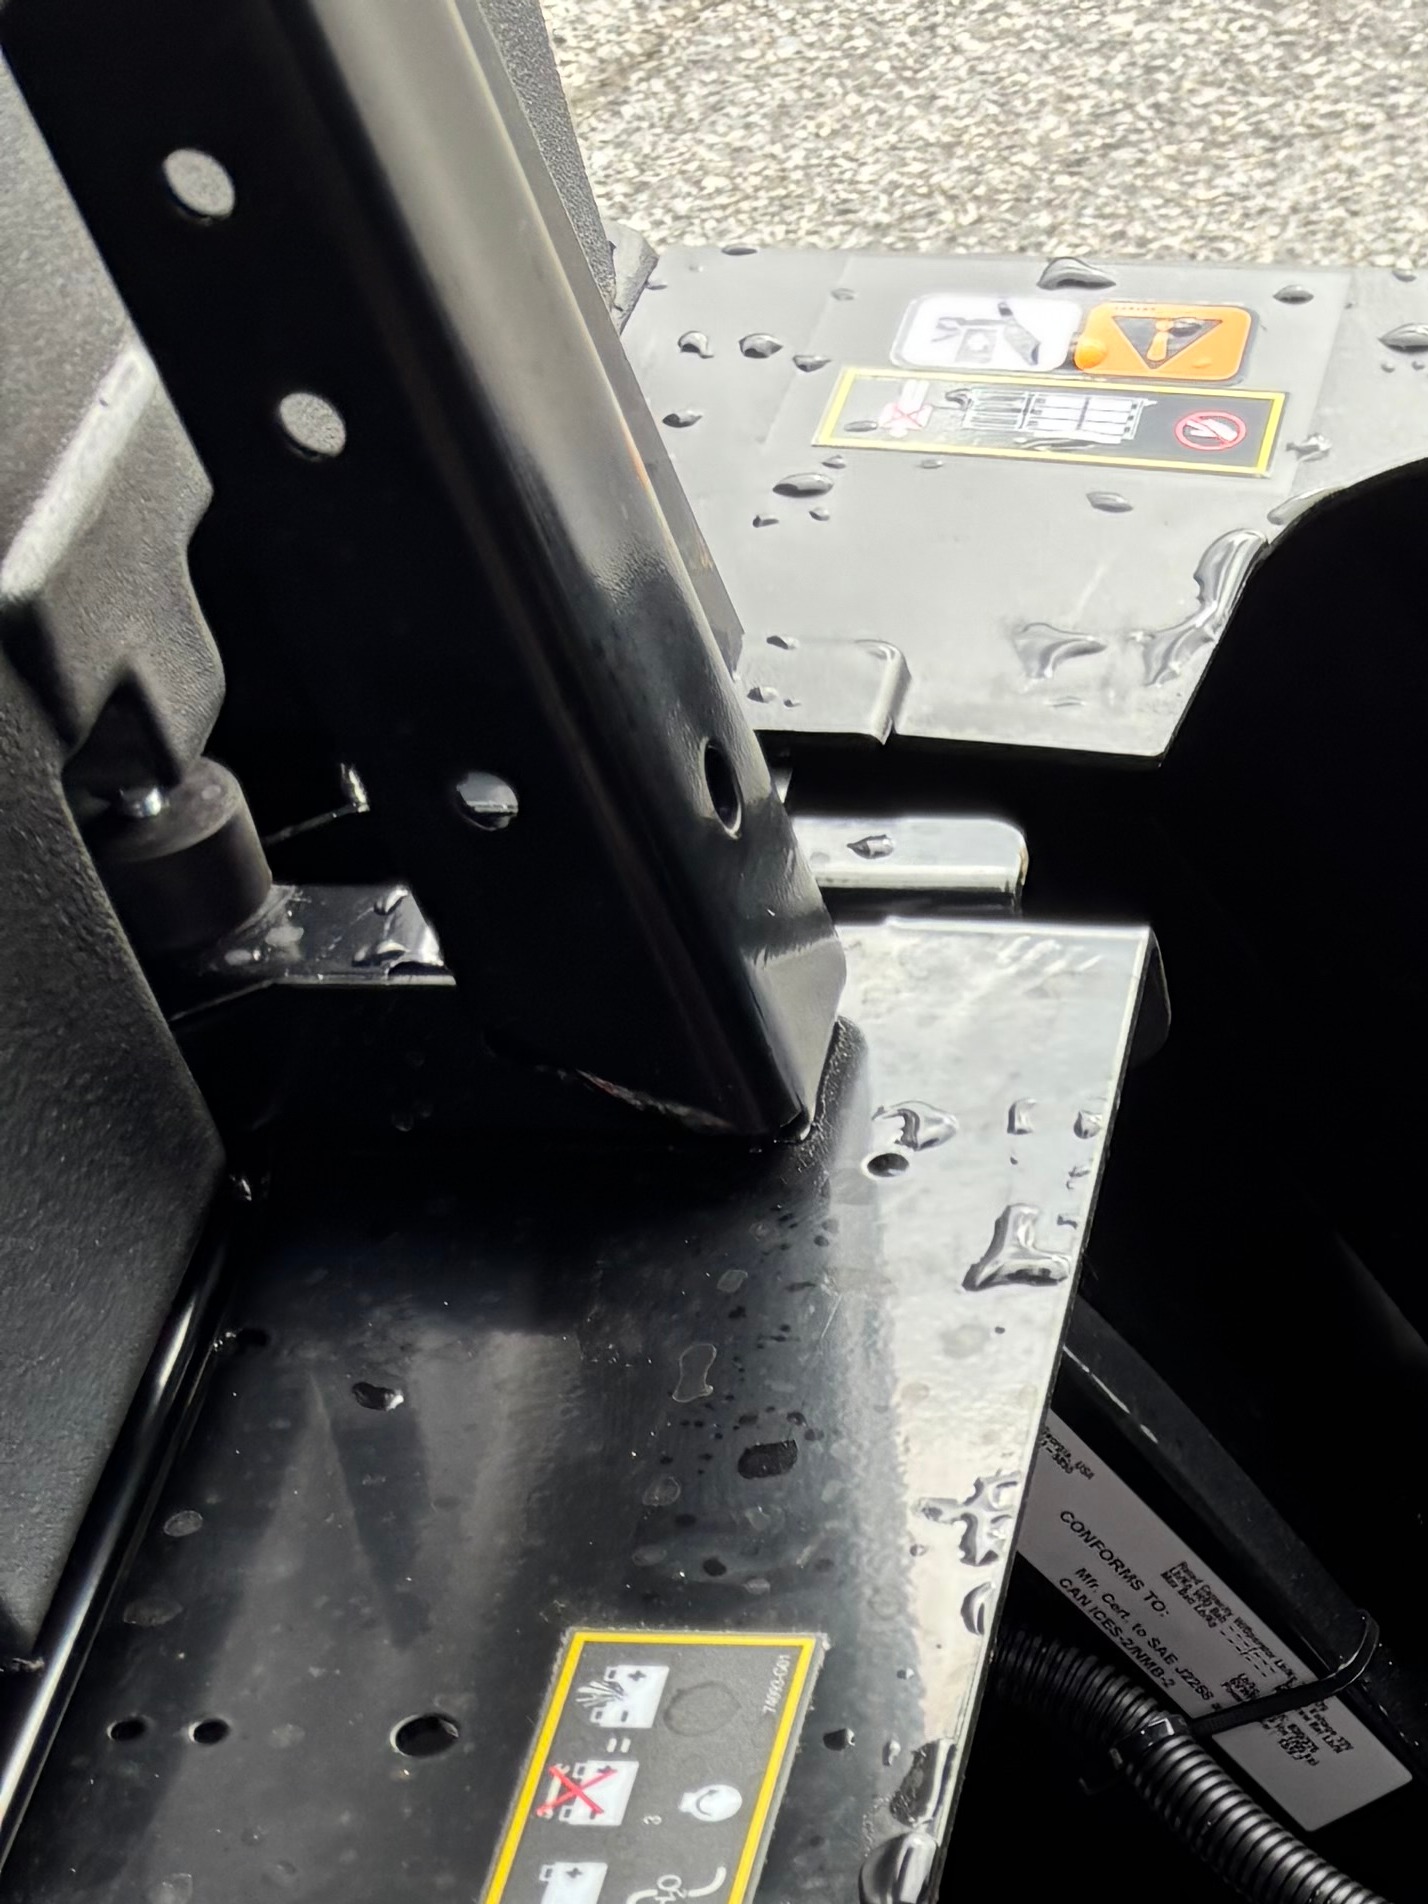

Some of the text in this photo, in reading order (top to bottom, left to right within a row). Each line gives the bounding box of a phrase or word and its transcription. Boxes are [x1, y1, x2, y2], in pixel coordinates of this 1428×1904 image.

[1073, 1458, 1095, 1481] USA
[1056, 1509, 1173, 1618] CONFORMS TO:
[1056, 1575, 1094, 1608] CAN
[1073, 1567, 1102, 1591] Mfr.
[1130, 1622, 1150, 1637] to
[1145, 1637, 1178, 1665] SAE
